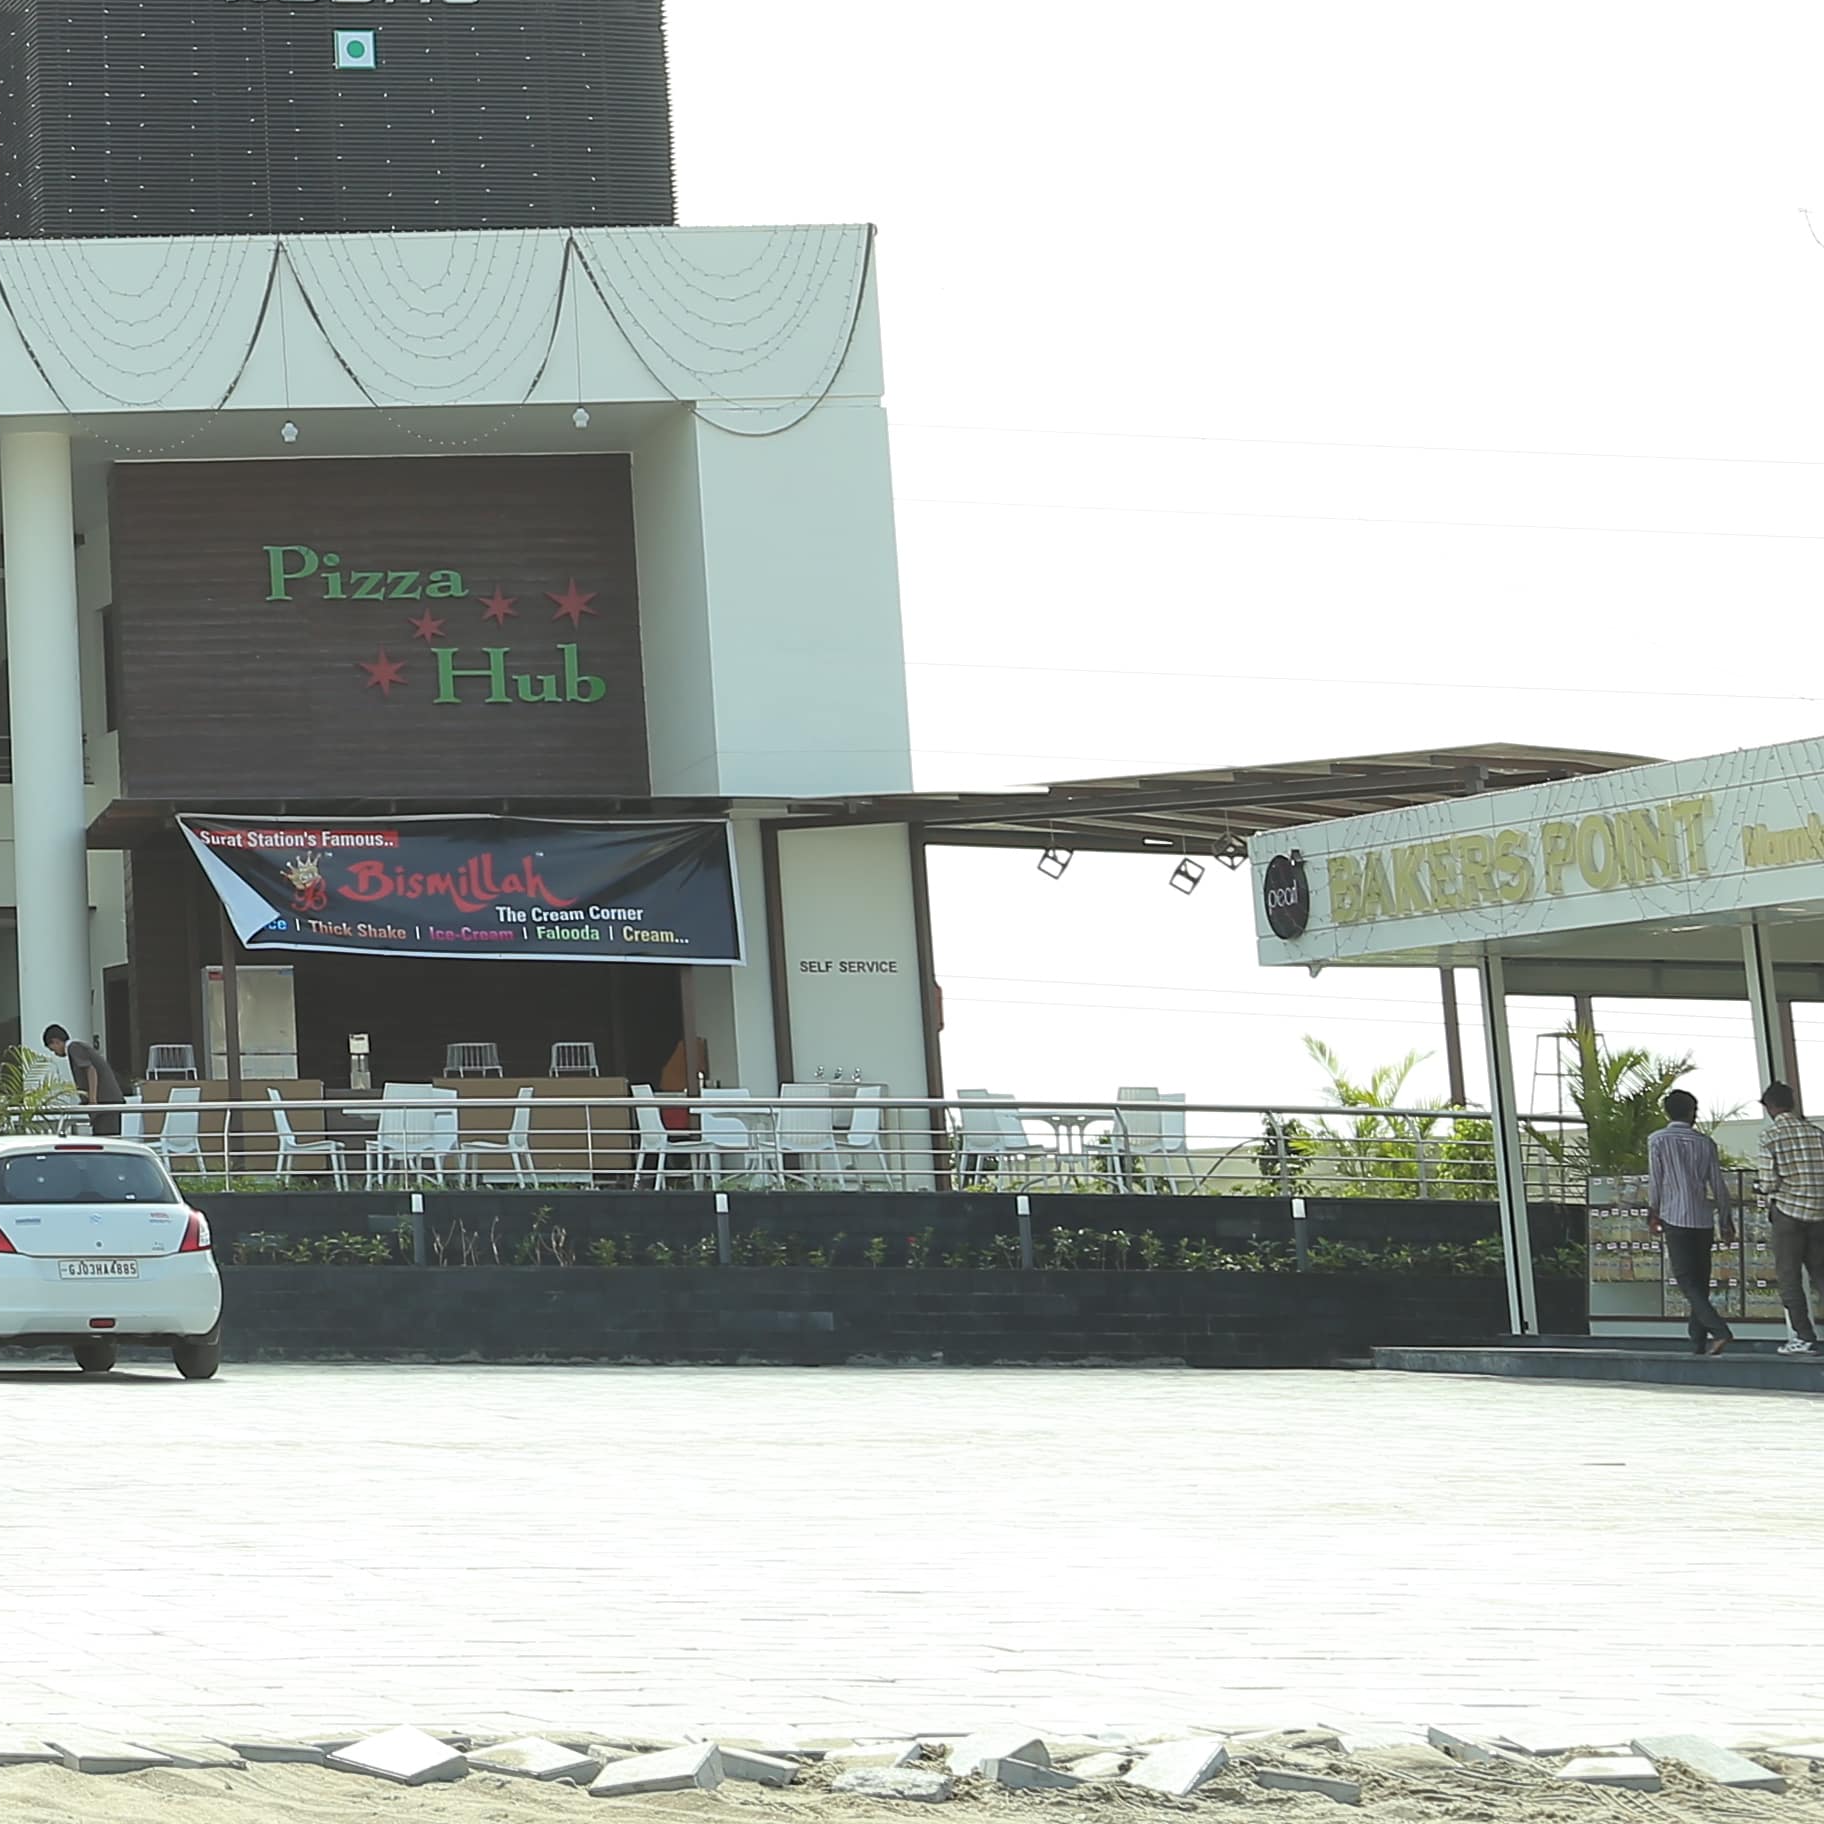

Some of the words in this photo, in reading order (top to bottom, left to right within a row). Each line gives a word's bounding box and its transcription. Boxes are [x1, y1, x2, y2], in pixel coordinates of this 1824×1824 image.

[263, 544, 469, 601] Pizza
[431, 642, 608, 704] Hub
[199, 829, 243, 848] Surat
[247, 830, 317, 848] Station's
[1327, 829, 1535, 924] BAKERS
[1540, 794, 1714, 896] POINT
[337, 852, 581, 913] Bismillah
[307, 920, 353, 938] Thick
[356, 923, 407, 940] Shake
[428, 926, 515, 942] Ice-Cream
[536, 925, 600, 941] Falooda
[495, 905, 527, 923] The
[531, 906, 585, 922] Cream
[588, 905, 645, 921] Corner
[799, 960, 833, 973] SELF
[838, 960, 898, 973] SERVICE
